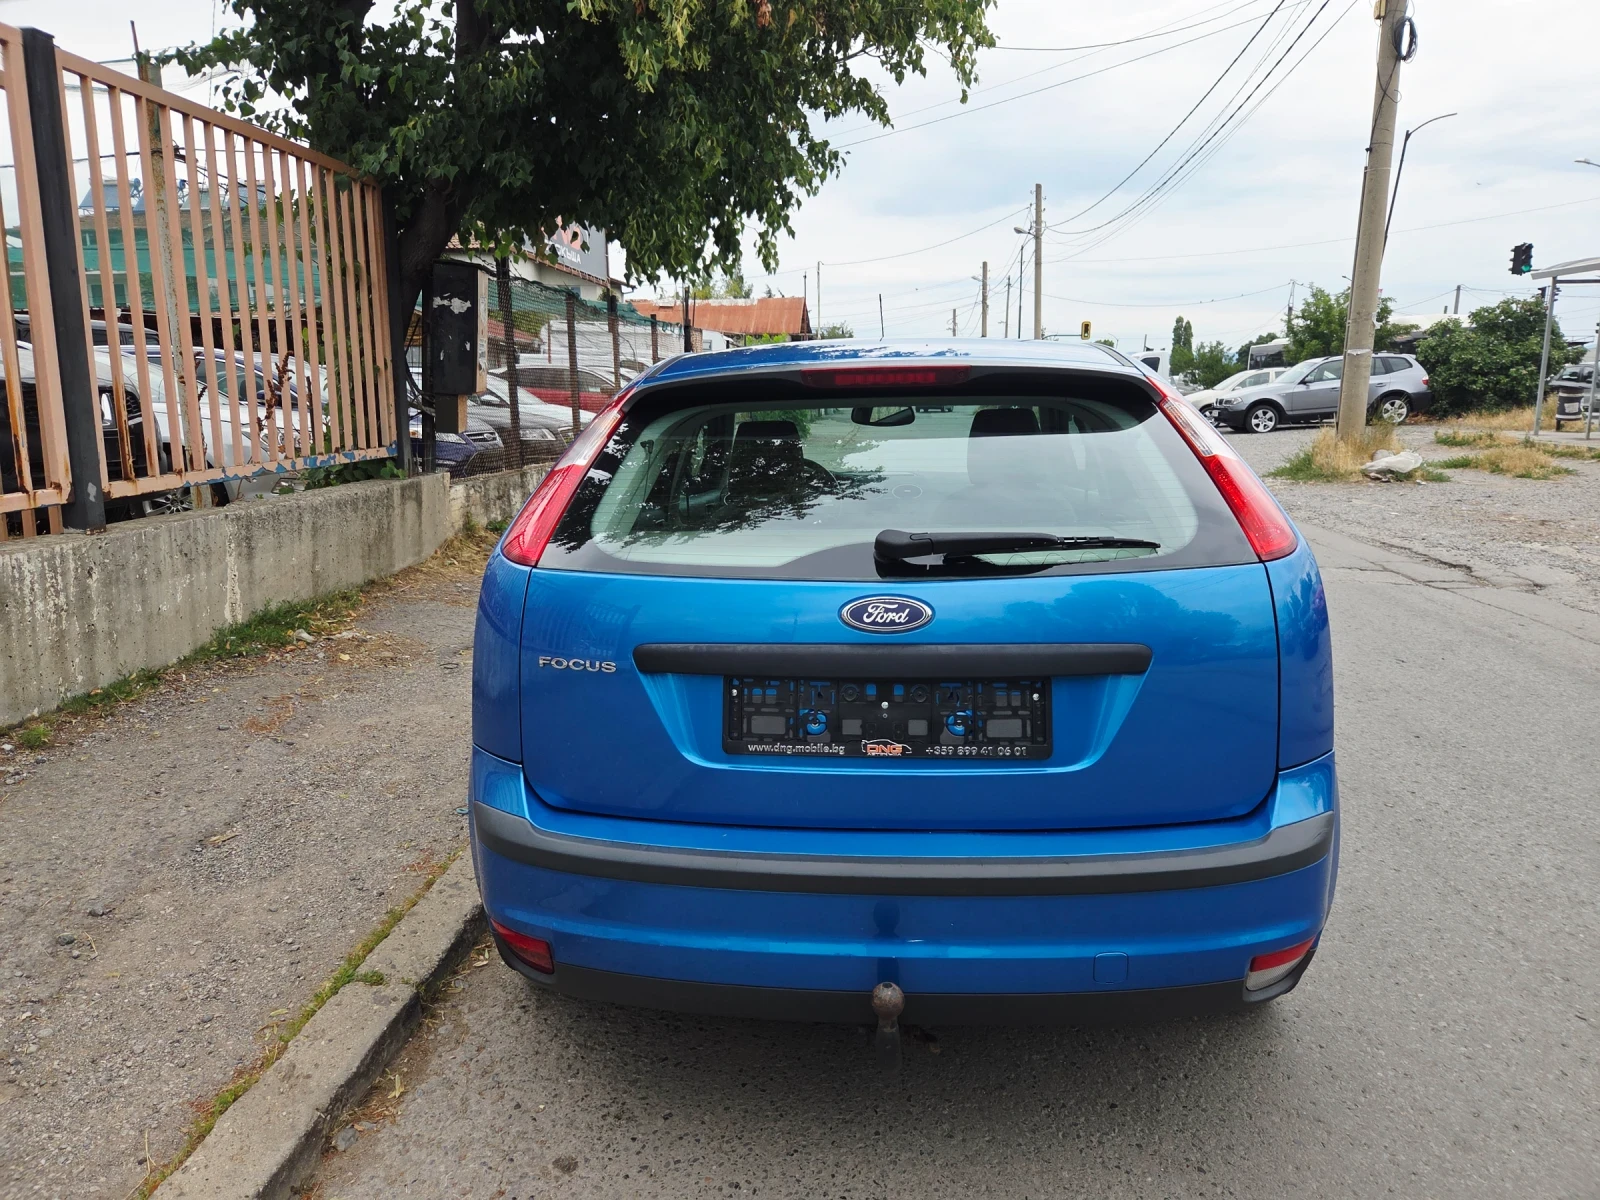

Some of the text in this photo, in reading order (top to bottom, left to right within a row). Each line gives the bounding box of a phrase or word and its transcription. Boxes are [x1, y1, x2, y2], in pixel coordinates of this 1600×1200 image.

[862, 603, 910, 623] Ford
[538, 655, 617, 673] FOCUS
[748, 742, 845, 755] www.dng.mobile.bg
[866, 744, 903, 754] DNG
[925, 745, 1027, 756] +359 899 41 06 01
